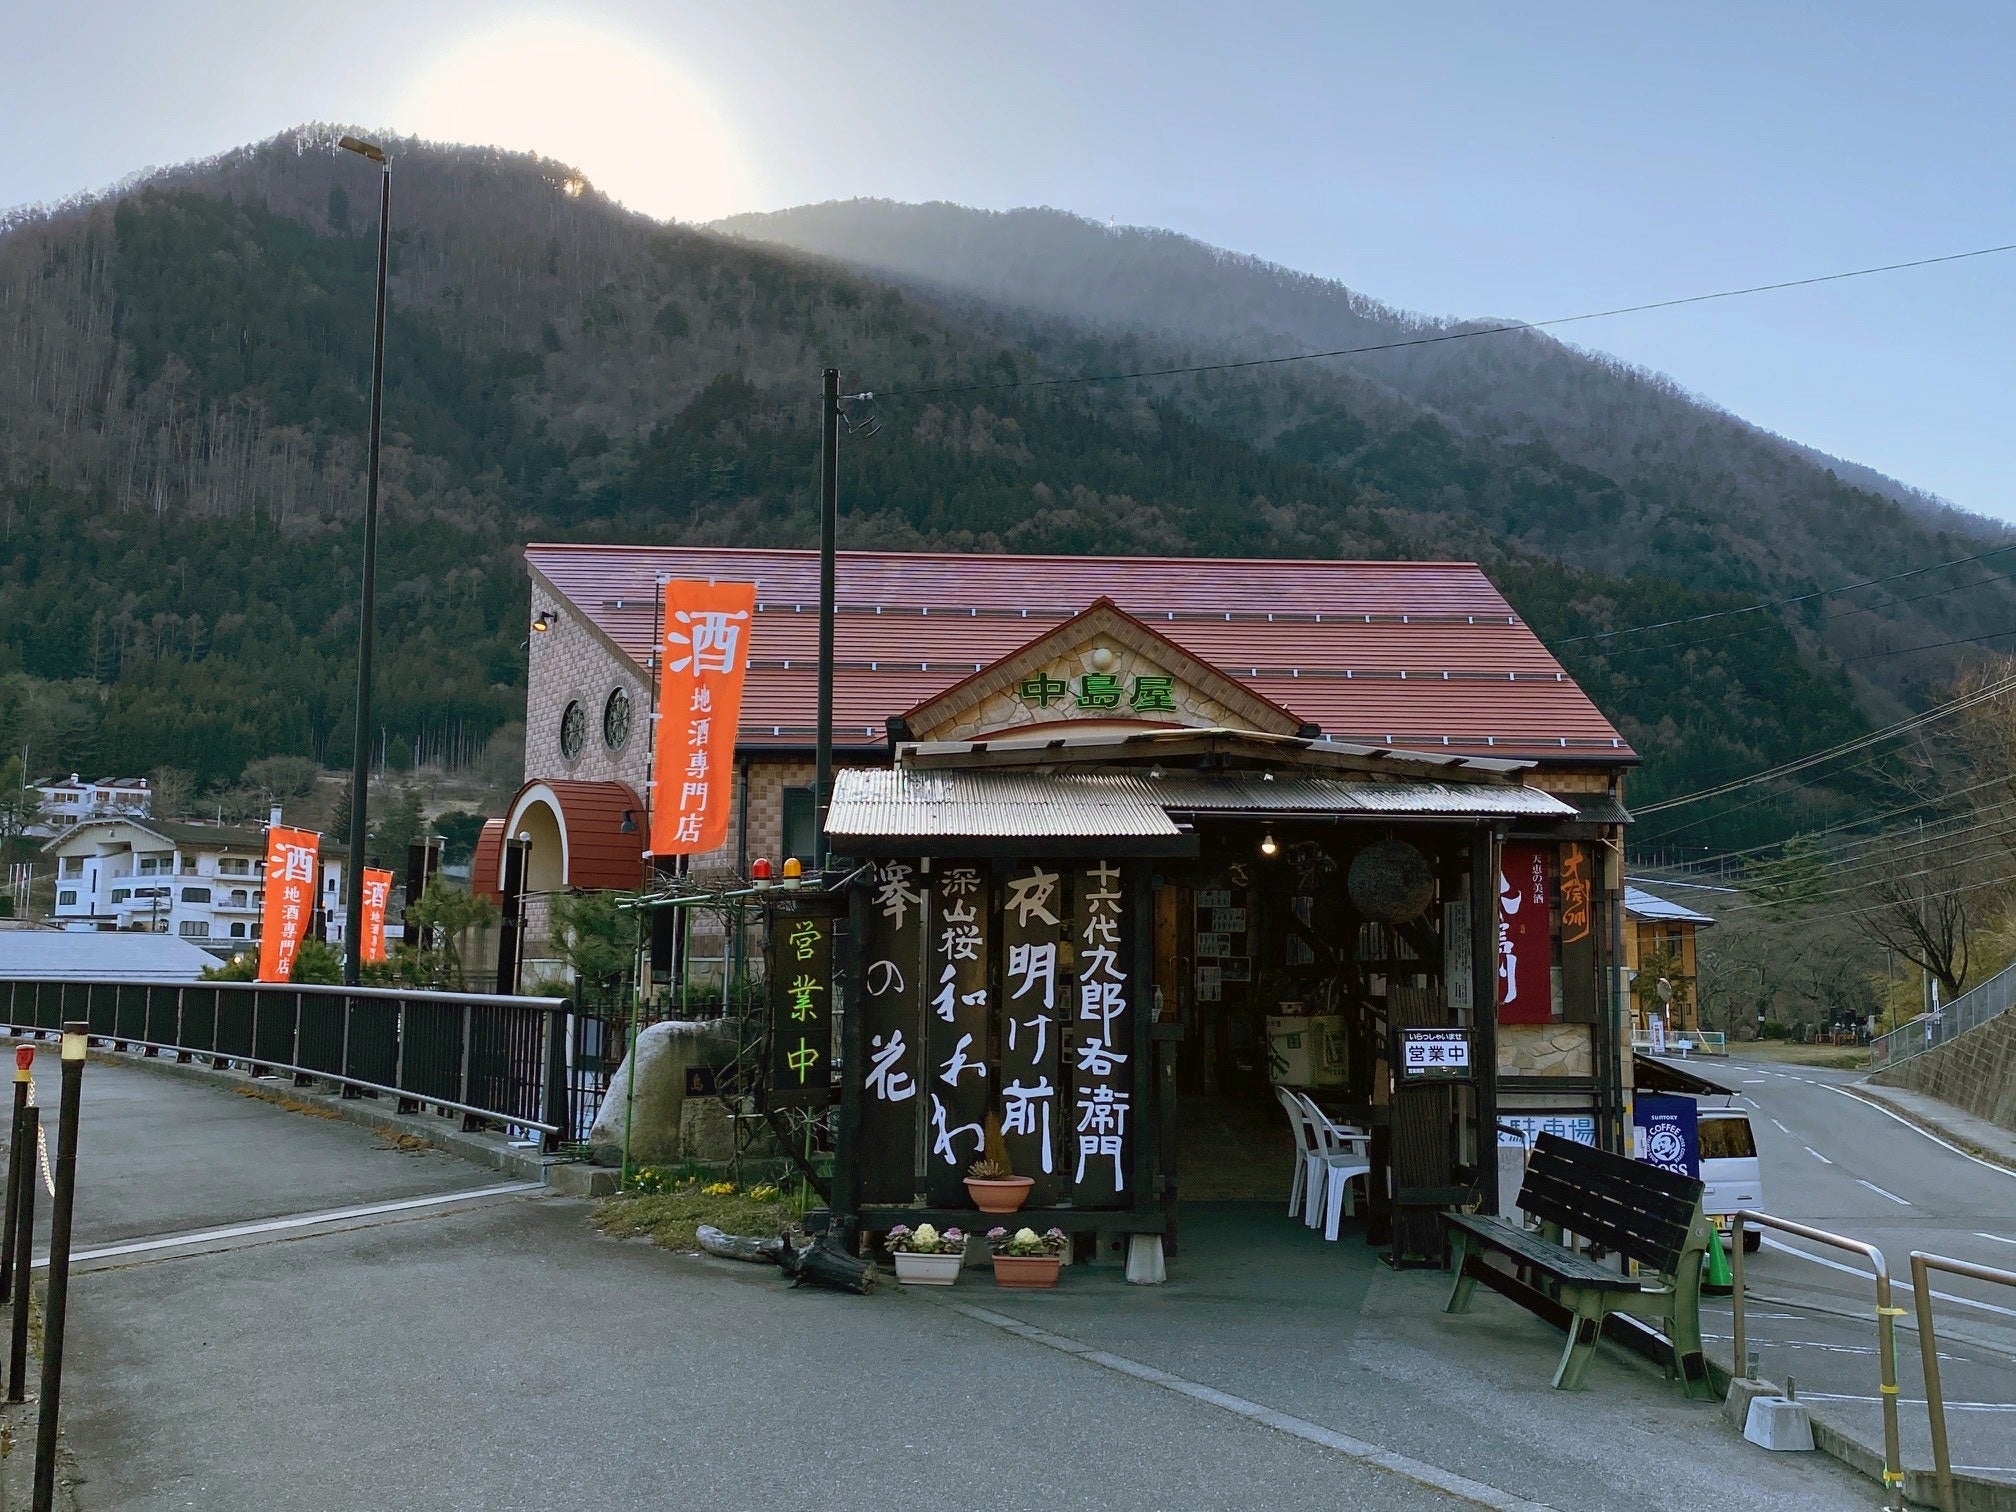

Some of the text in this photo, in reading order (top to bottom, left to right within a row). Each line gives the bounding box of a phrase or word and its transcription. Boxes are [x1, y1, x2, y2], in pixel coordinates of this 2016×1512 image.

[668, 610, 748, 677] 酒
[1020, 671, 1177, 711] 中島屋
[674, 685, 712, 842] 地酒専門店
[270, 843, 316, 884] 酒
[1532, 854, 1544, 904] 天恵の美酒
[363, 881, 388, 908] 酒
[275, 886, 301, 974] 地酒専門店
[788, 920, 824, 1084] 営業中
[1001, 866, 1060, 1174] 夜明け前
[1409, 1033, 1462, 1041] いらっしゃいませ
[1409, 1045, 1464, 1062] 営業中
[1649, 1123, 1681, 1136] COFFEE
